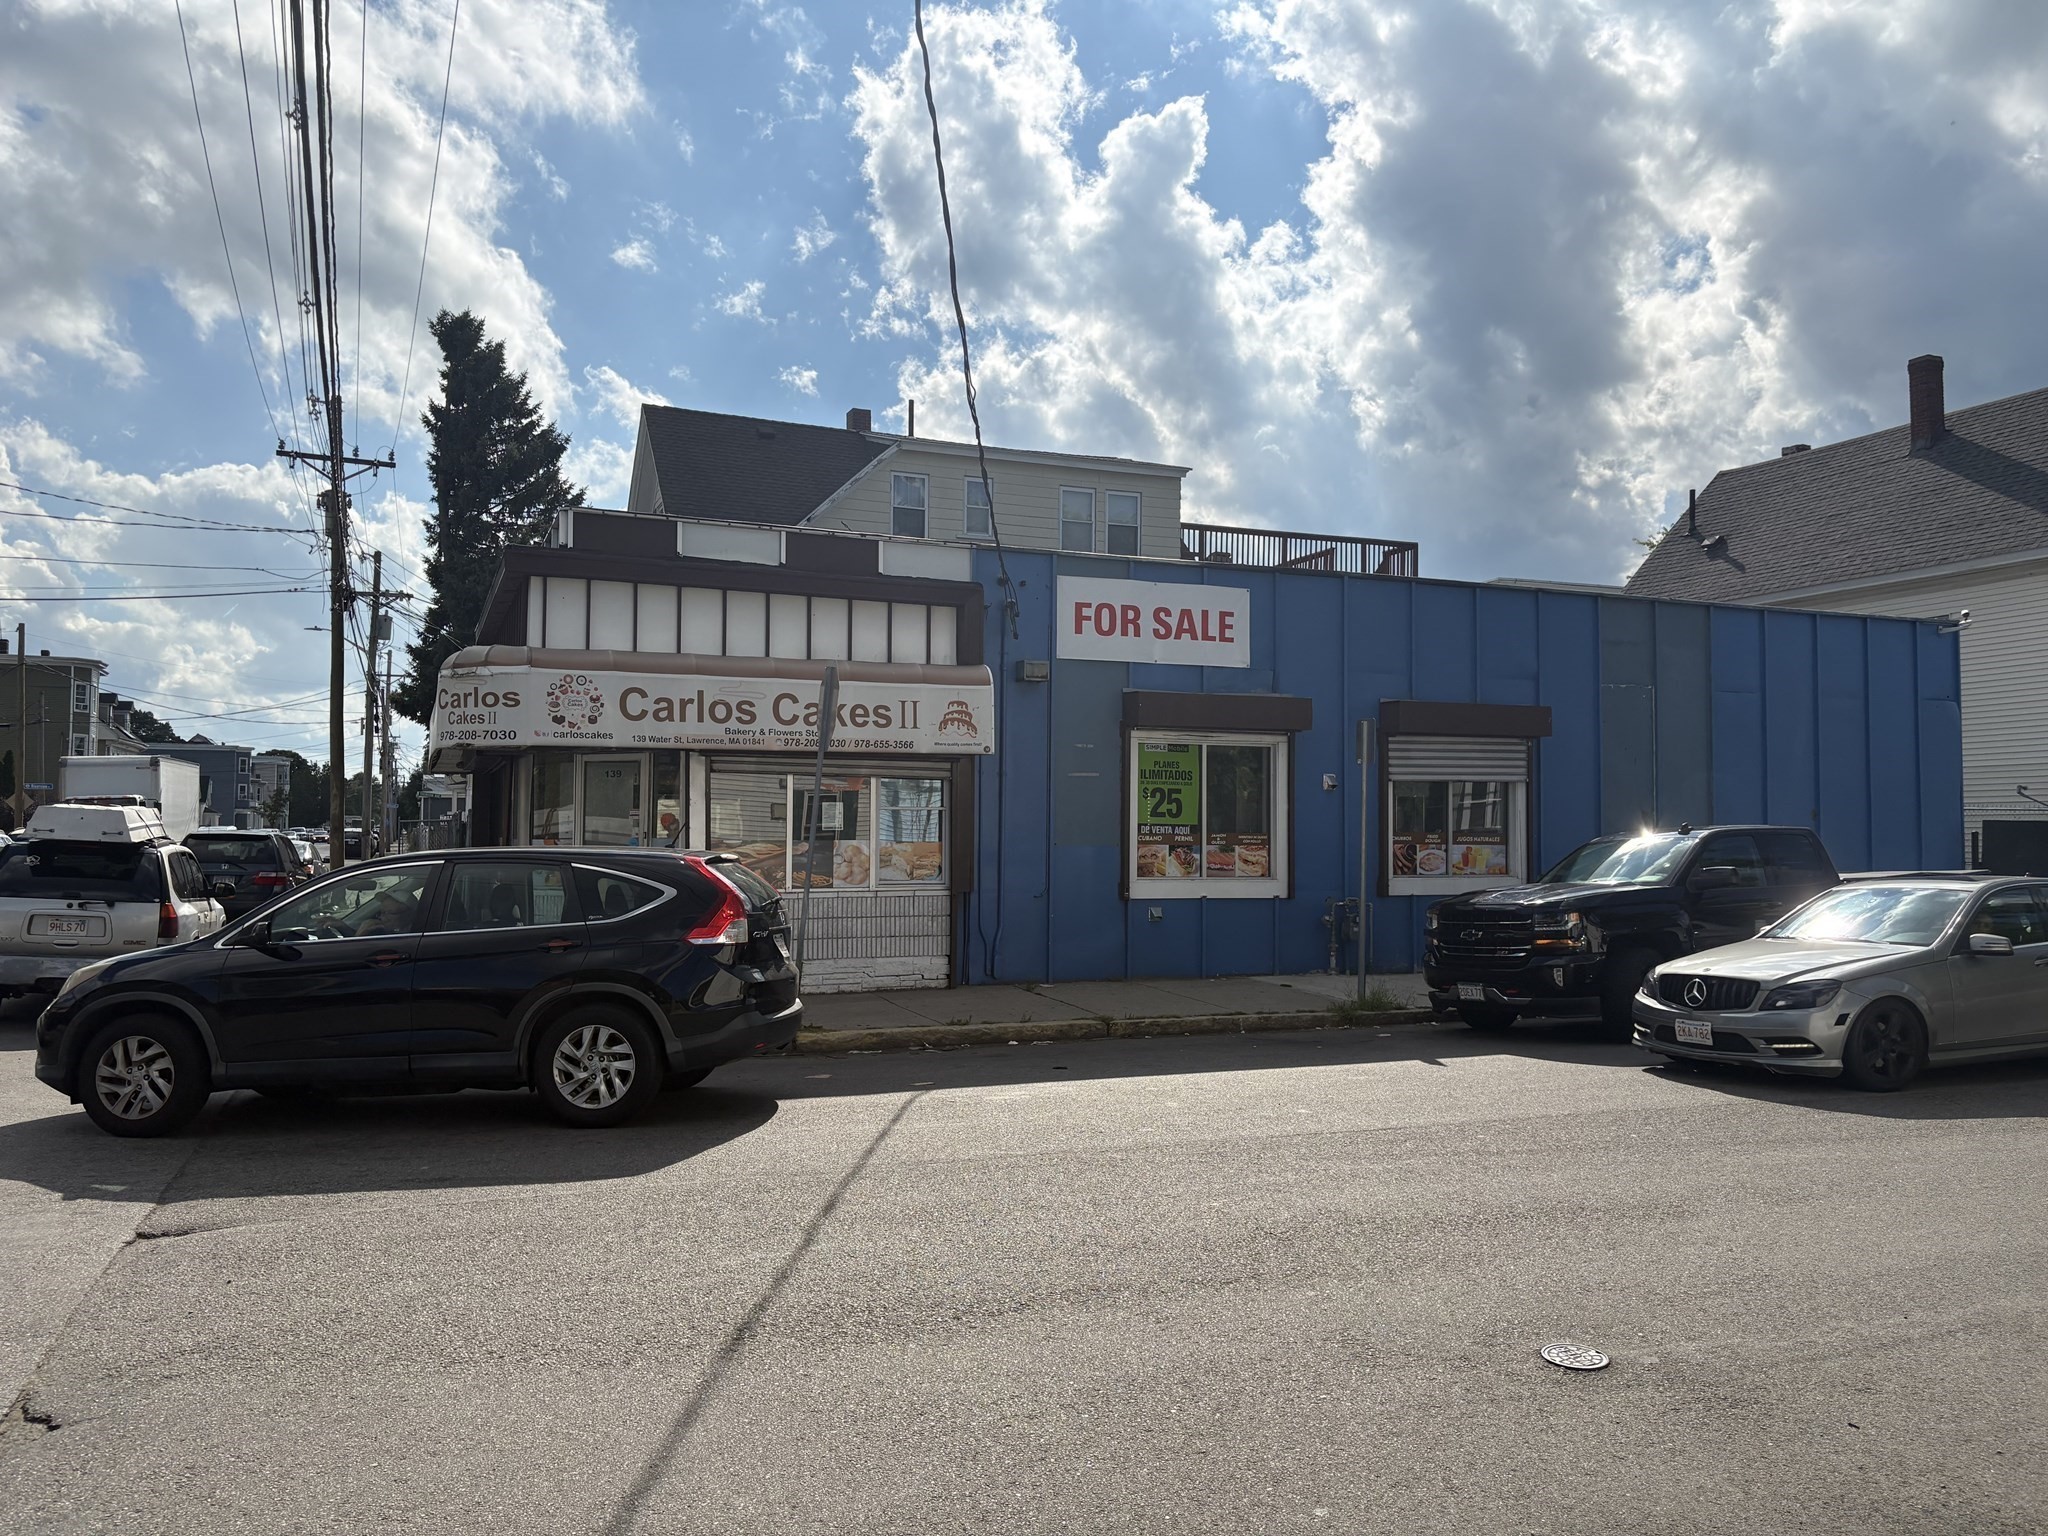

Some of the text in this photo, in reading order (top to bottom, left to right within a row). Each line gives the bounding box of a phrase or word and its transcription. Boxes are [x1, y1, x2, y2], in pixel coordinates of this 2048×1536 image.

[1074, 602, 1235, 643] FOR SALE
[438, 687, 521, 709] Carlos
[619, 687, 921, 729] Carlos Cakes II
[448, 711, 497, 725] Cakes II
[440, 729, 517, 741] 978-208-7030
[553, 730, 614, 739] carloscakes
[724, 727, 757, 737] Bakery
[759, 728, 766, 736] &
[768, 728, 803, 737] Flowers
[632, 735, 646, 743] 139
[648, 735, 672, 743] Water
[674, 736, 684, 744] St,
[686, 737, 727, 745] Lawrence,
[742, 738, 765, 746] 01841
[783, 738, 846, 748] 978-208030
[854, 739, 914, 749] 978-655-3566
[1153, 760, 1180, 769] PLANES
[605, 769, 622, 778] 139
[1140, 769, 1193, 781] ILIMITADOS
[1142, 786, 1183, 819] $25
[1151, 825, 1173, 834] VENTA
[1174, 825, 1191, 835] AQUÍ
